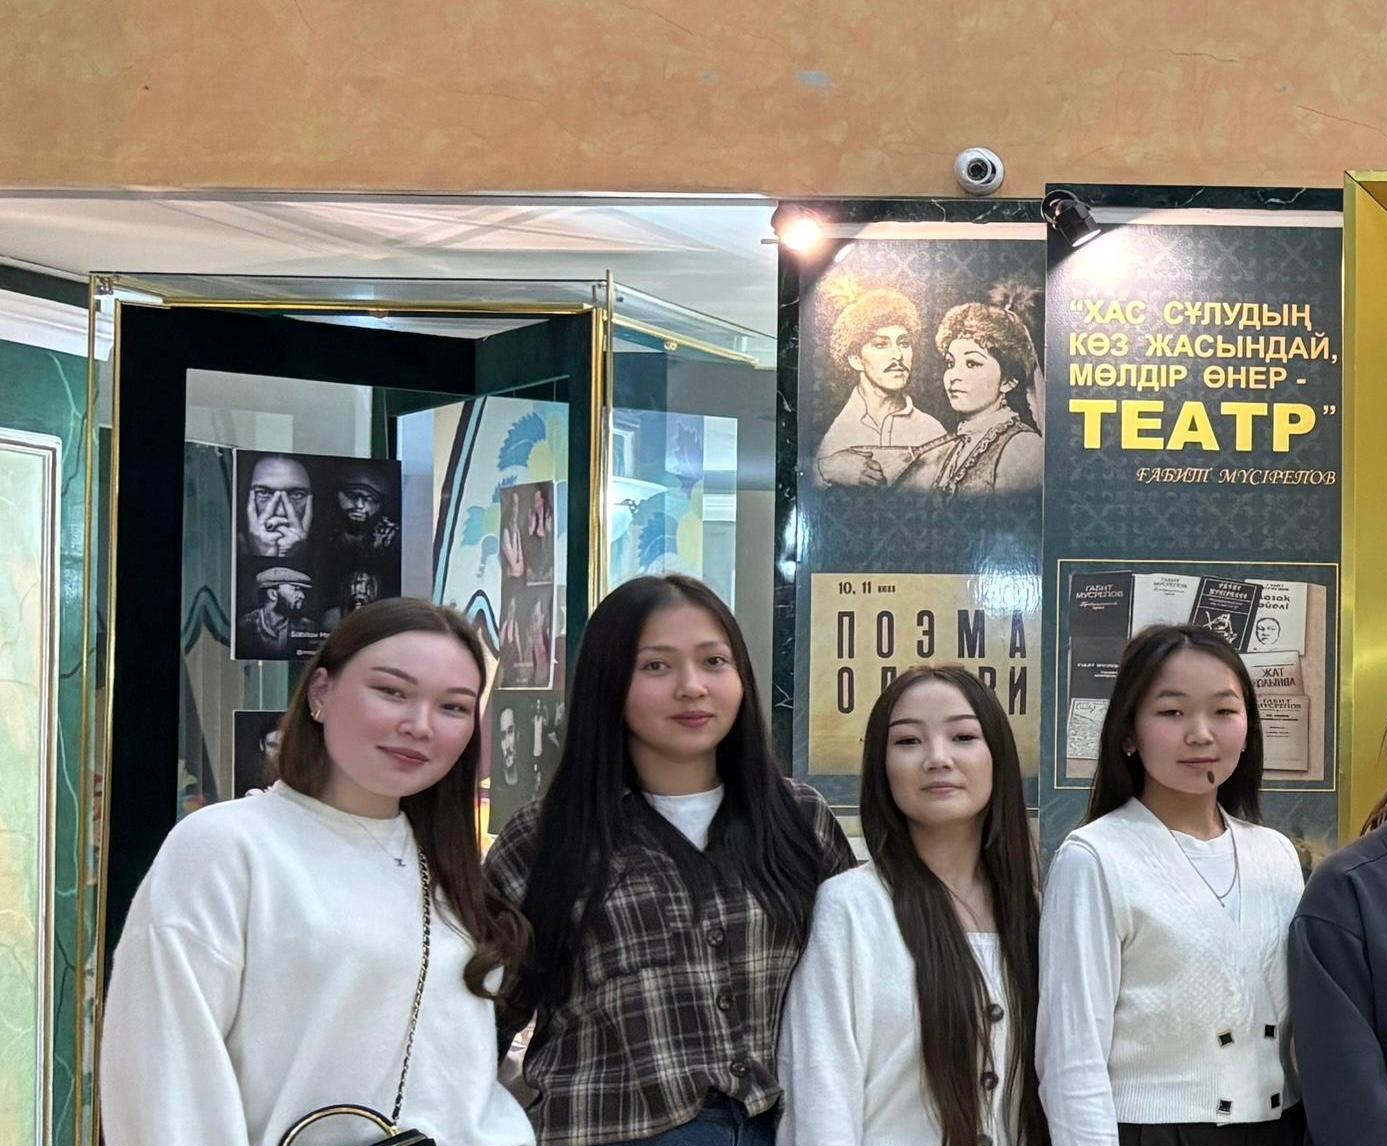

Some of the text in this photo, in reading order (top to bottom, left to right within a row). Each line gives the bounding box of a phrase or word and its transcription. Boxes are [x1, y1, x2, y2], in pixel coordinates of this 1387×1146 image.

[1163, 301, 1312, 331] СҰЛУДЫҢ
[1069, 331, 1338, 364] КӨЗ ЖАСЫНДАЙ,
[1069, 363, 1188, 391] МӨЛДІР
[1203, 366, 1288, 389] ӨНЕР
[1218, 468, 1337, 486] МҮСІРЕПОВ
[862, 580, 871, 594] 11
[837, 609, 1027, 659] ПОЭМА
